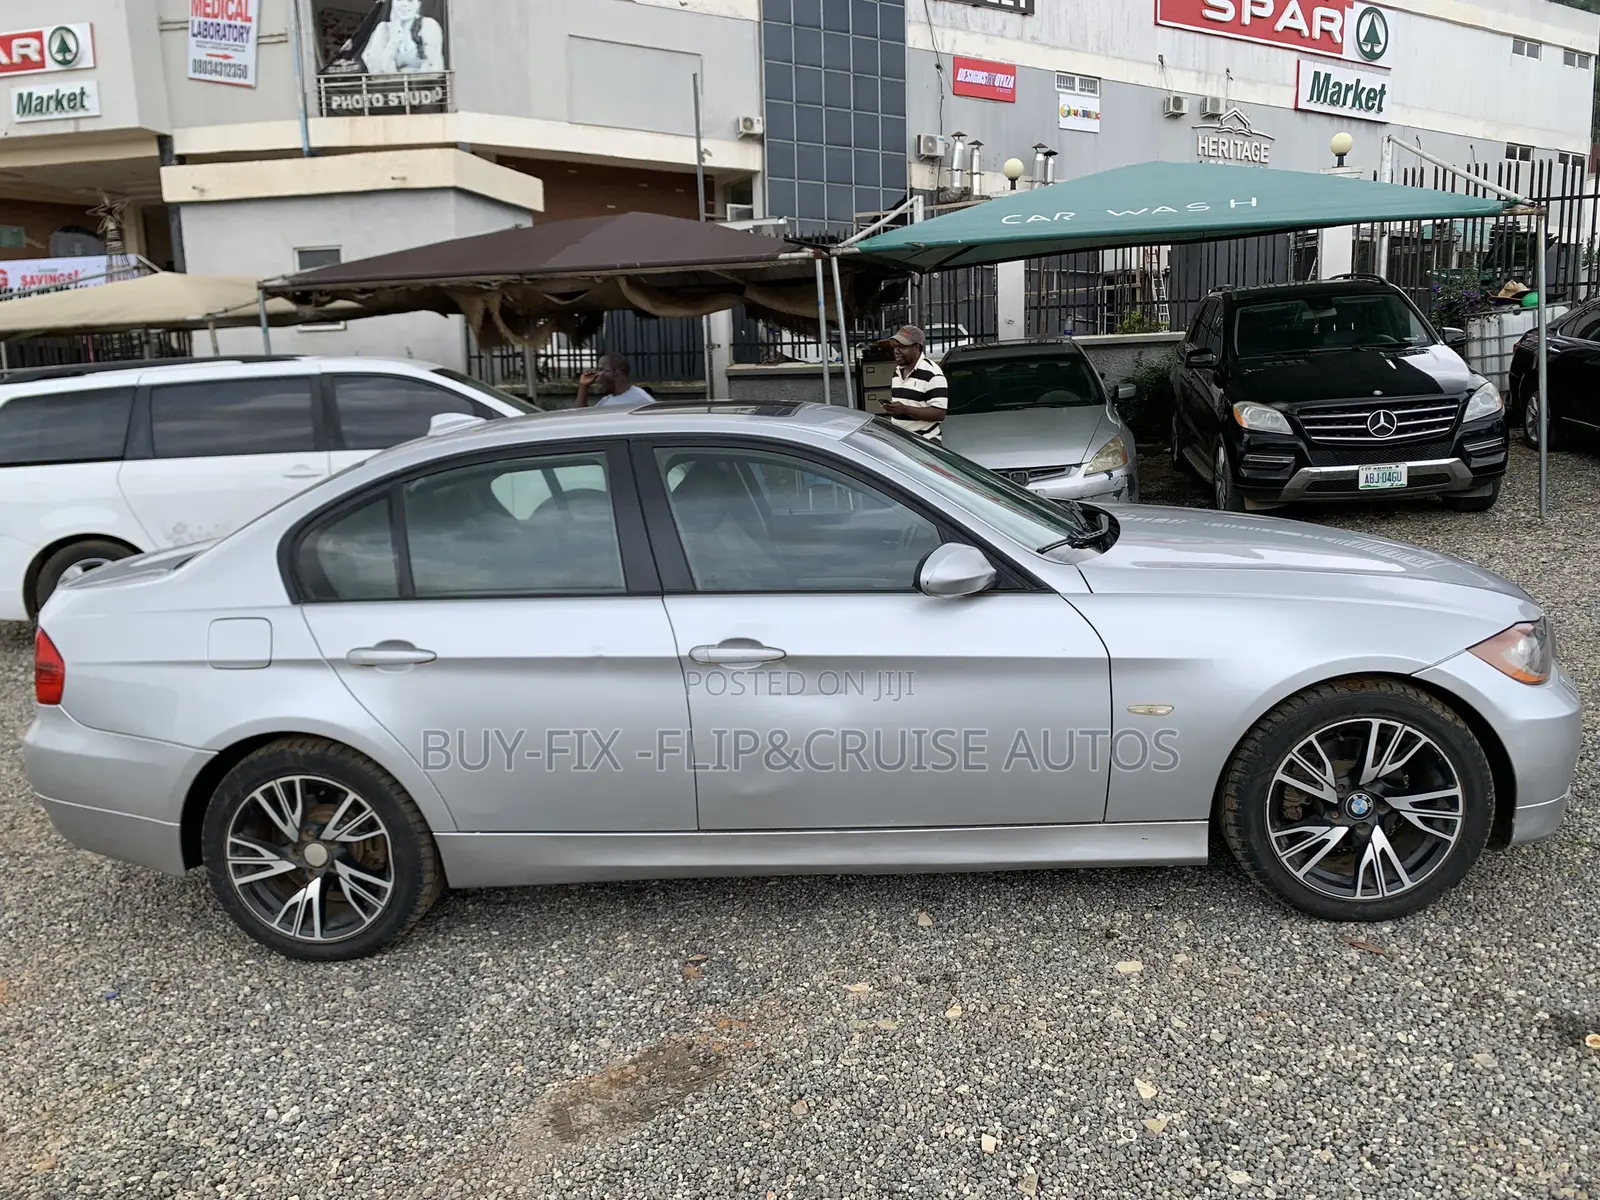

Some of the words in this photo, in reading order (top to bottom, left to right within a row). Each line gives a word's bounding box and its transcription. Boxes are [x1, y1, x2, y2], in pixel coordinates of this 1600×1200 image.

[191, 0, 252, 22] MEDICAL
[1202, 0, 1343, 44] SPAR
[191, 20, 251, 43] LABORATORY
[16, 86, 86, 115] Market
[331, 93, 384, 110] PHOTO
[1309, 70, 1387, 113] Market
[1197, 135, 1270, 164] HERITAGE
[1001, 211, 1076, 225] CAR
[1106, 197, 1258, 217] WASH
